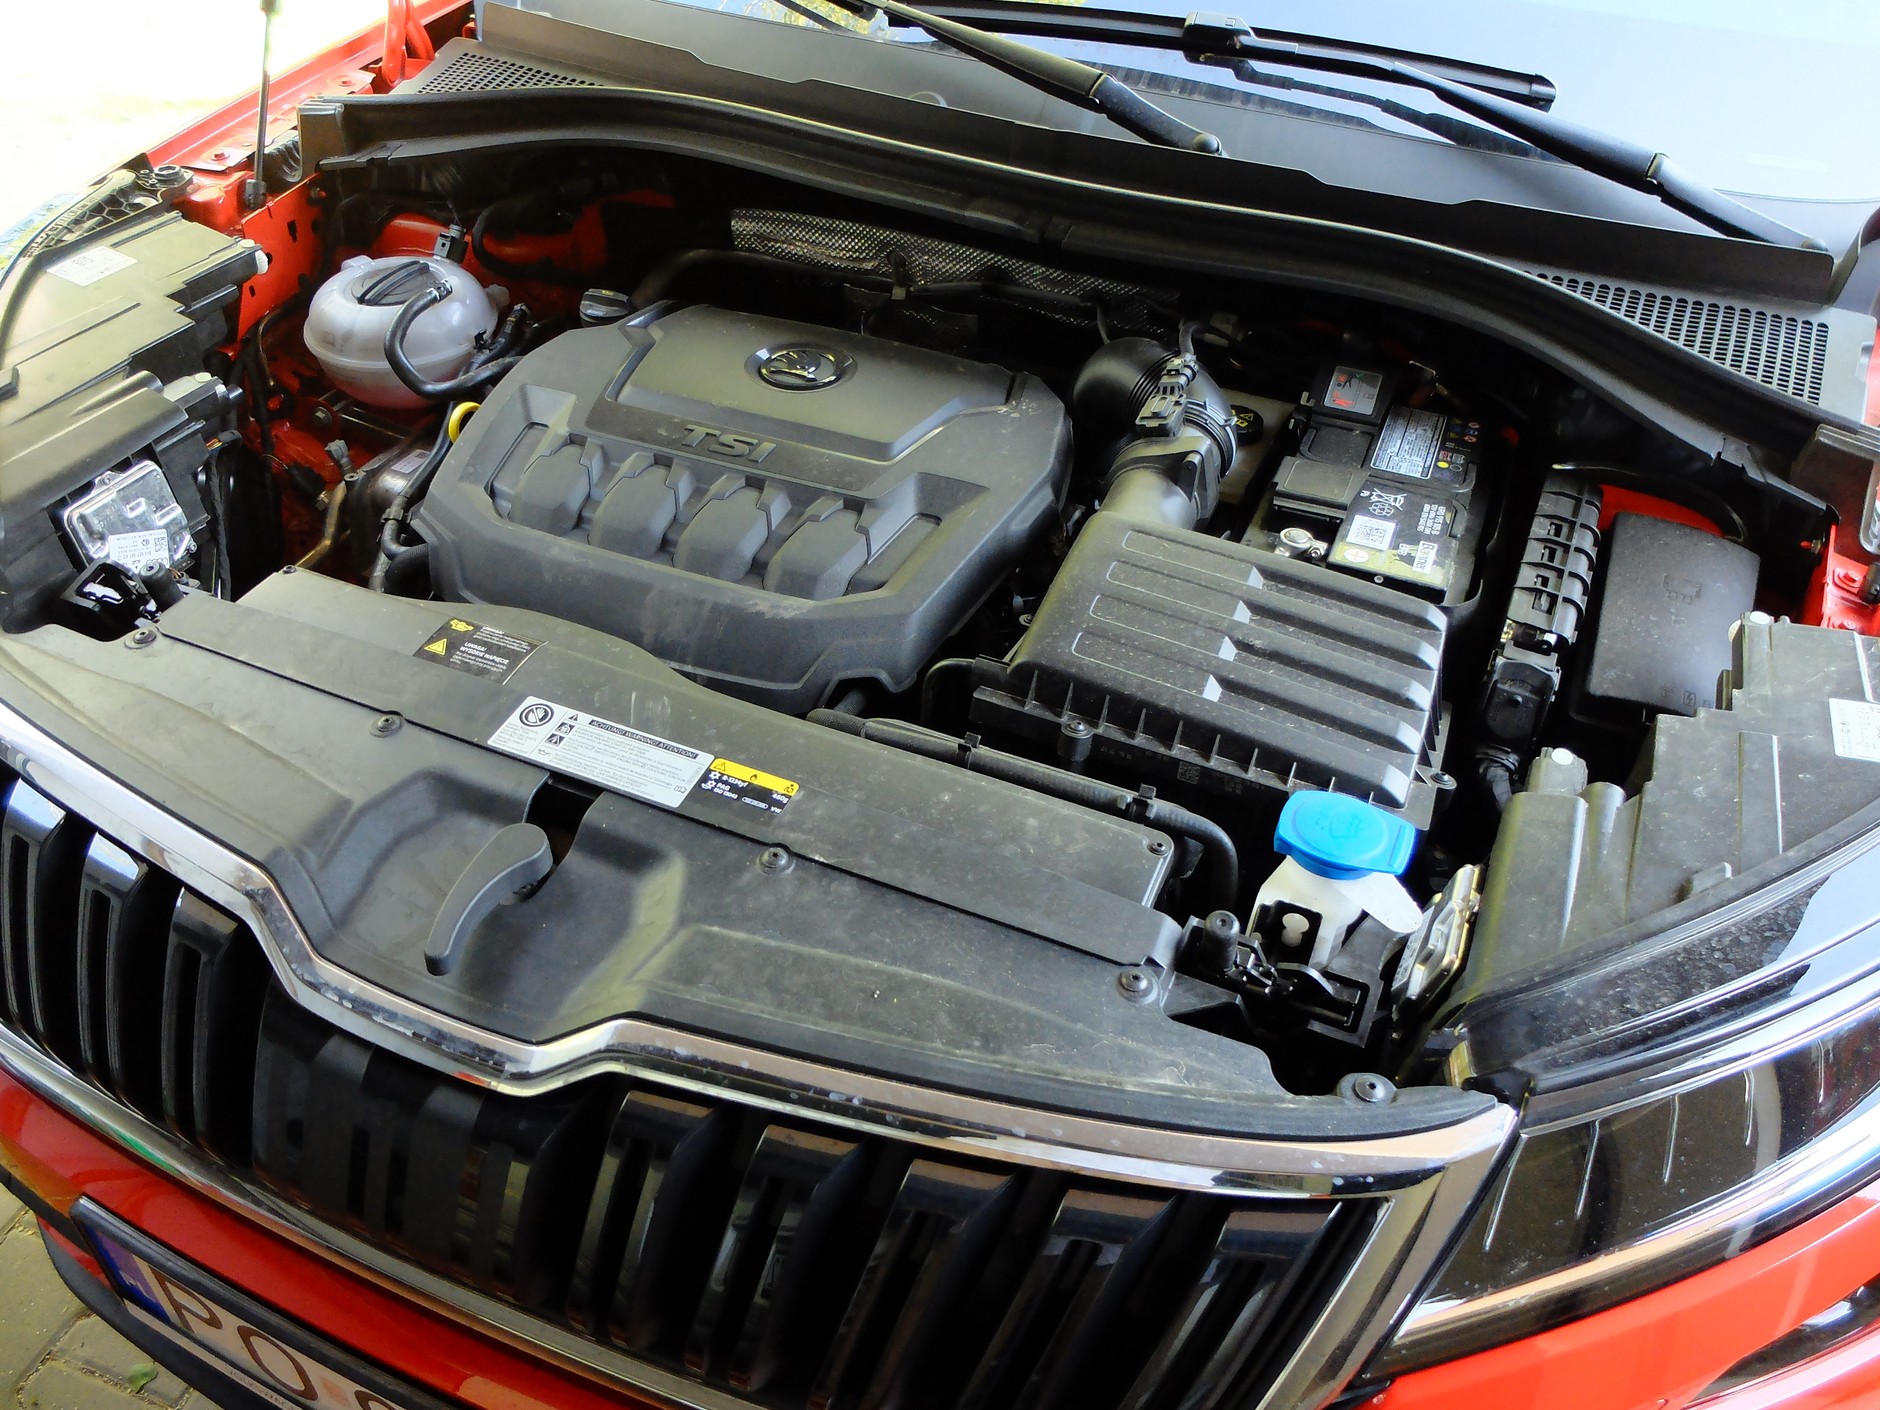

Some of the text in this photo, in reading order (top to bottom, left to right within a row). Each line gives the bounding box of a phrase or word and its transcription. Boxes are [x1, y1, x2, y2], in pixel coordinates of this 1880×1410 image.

[681, 424, 777, 464] TSI
[1415, 543, 1435, 571] Banner
[592, 720, 697, 759] ACHTUNG! WARNING! ATTENTION!
[716, 782, 731, 791] PAG
[772, 793, 789, 804] 460g
[770, 805, 782, 814] VW
